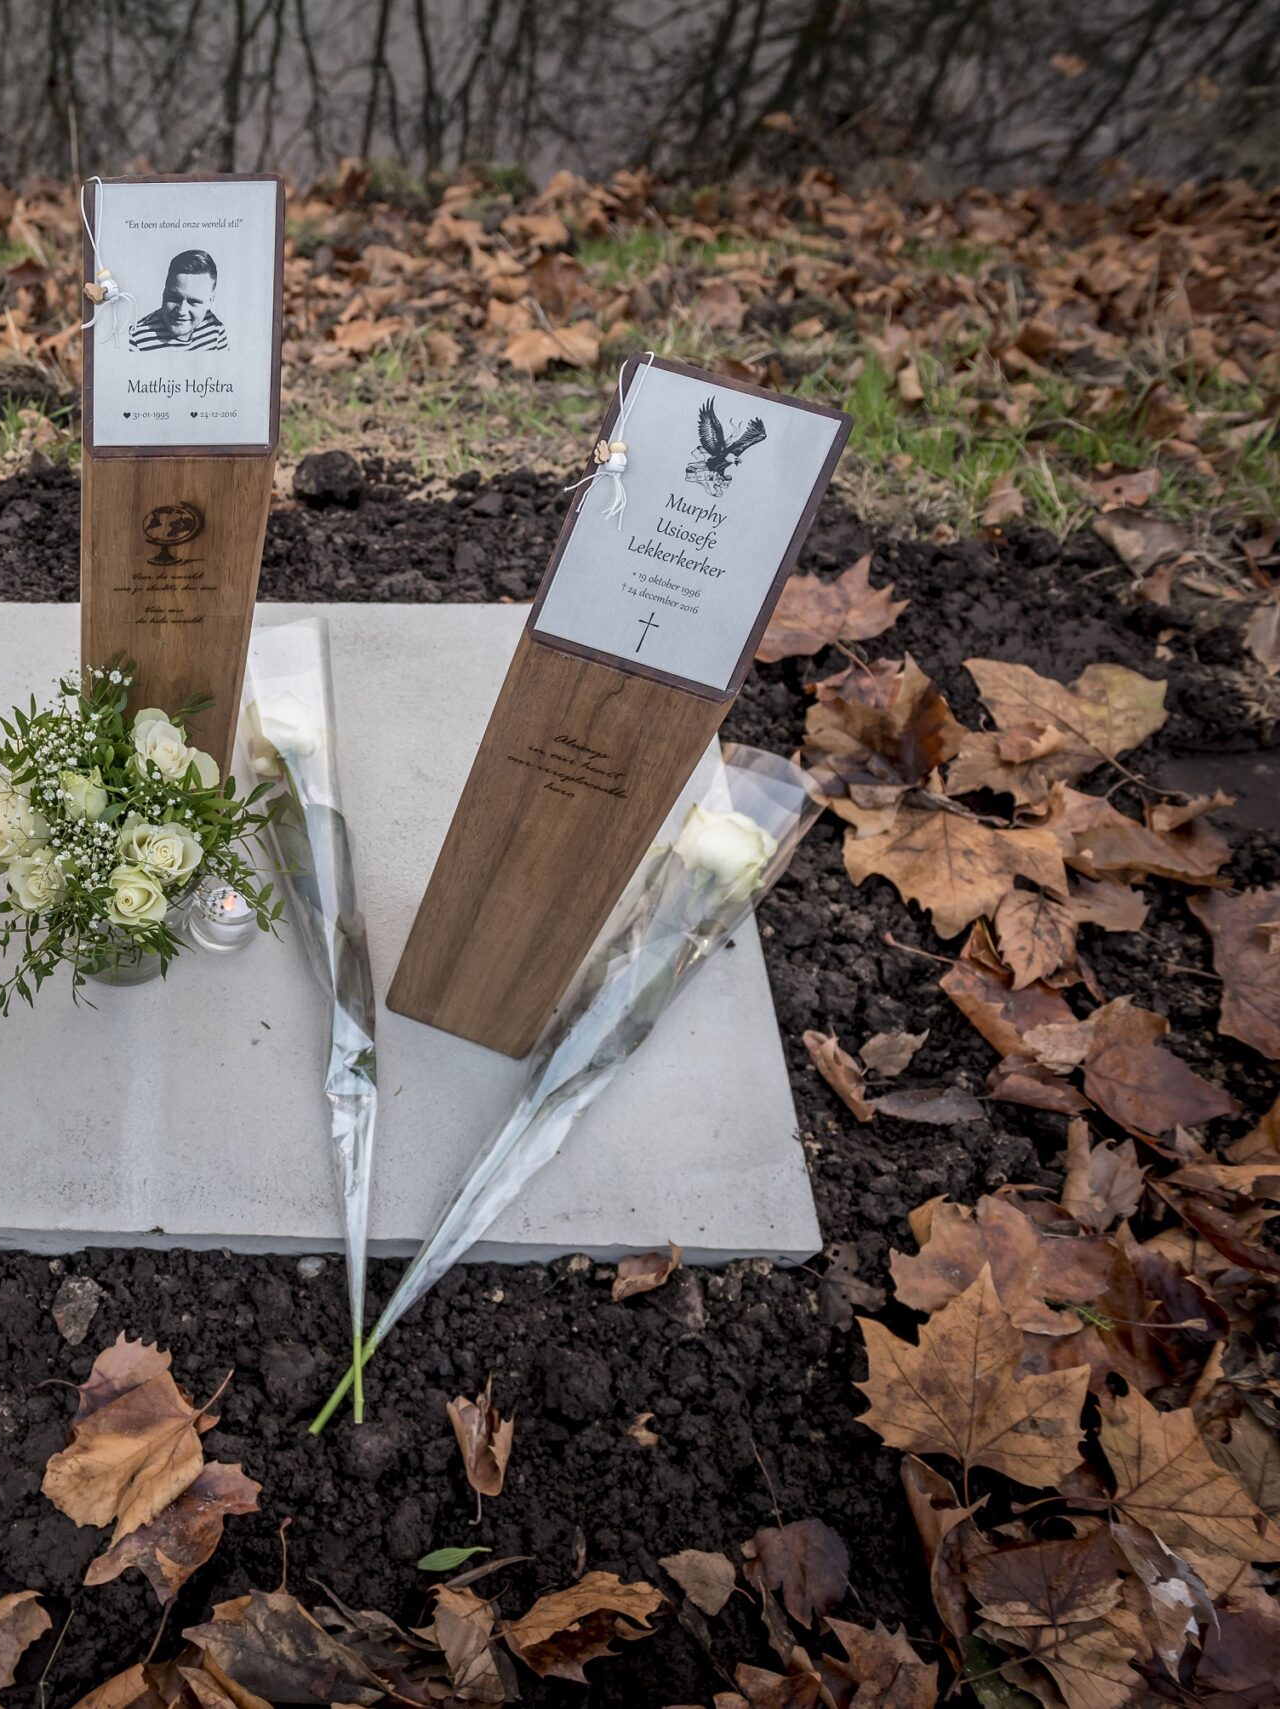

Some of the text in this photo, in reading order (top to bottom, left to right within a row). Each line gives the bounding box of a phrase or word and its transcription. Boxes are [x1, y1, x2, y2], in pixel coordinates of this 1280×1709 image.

[140, 219, 158, 229] toen
[159, 218, 181, 229] stond
[182, 221, 200, 229] onze
[201, 218, 226, 229] wereld
[127, 376, 234, 399] Matthijs Hofstra
[133, 409, 238, 421] 31-01-1995 24-12-2016
[665, 492, 728, 529] Murphy
[656, 517, 718, 552] Usiosefe
[627, 535, 726, 579] Lekkerkerker
[638, 572, 702, 599] 19 oktober 1996
[627, 586, 700, 615] 24 december 2016
[554, 735, 609, 760] Always
[507, 755, 535, 768] our
[527, 745, 626, 780] in our heart
[543, 781, 576, 799] hero
